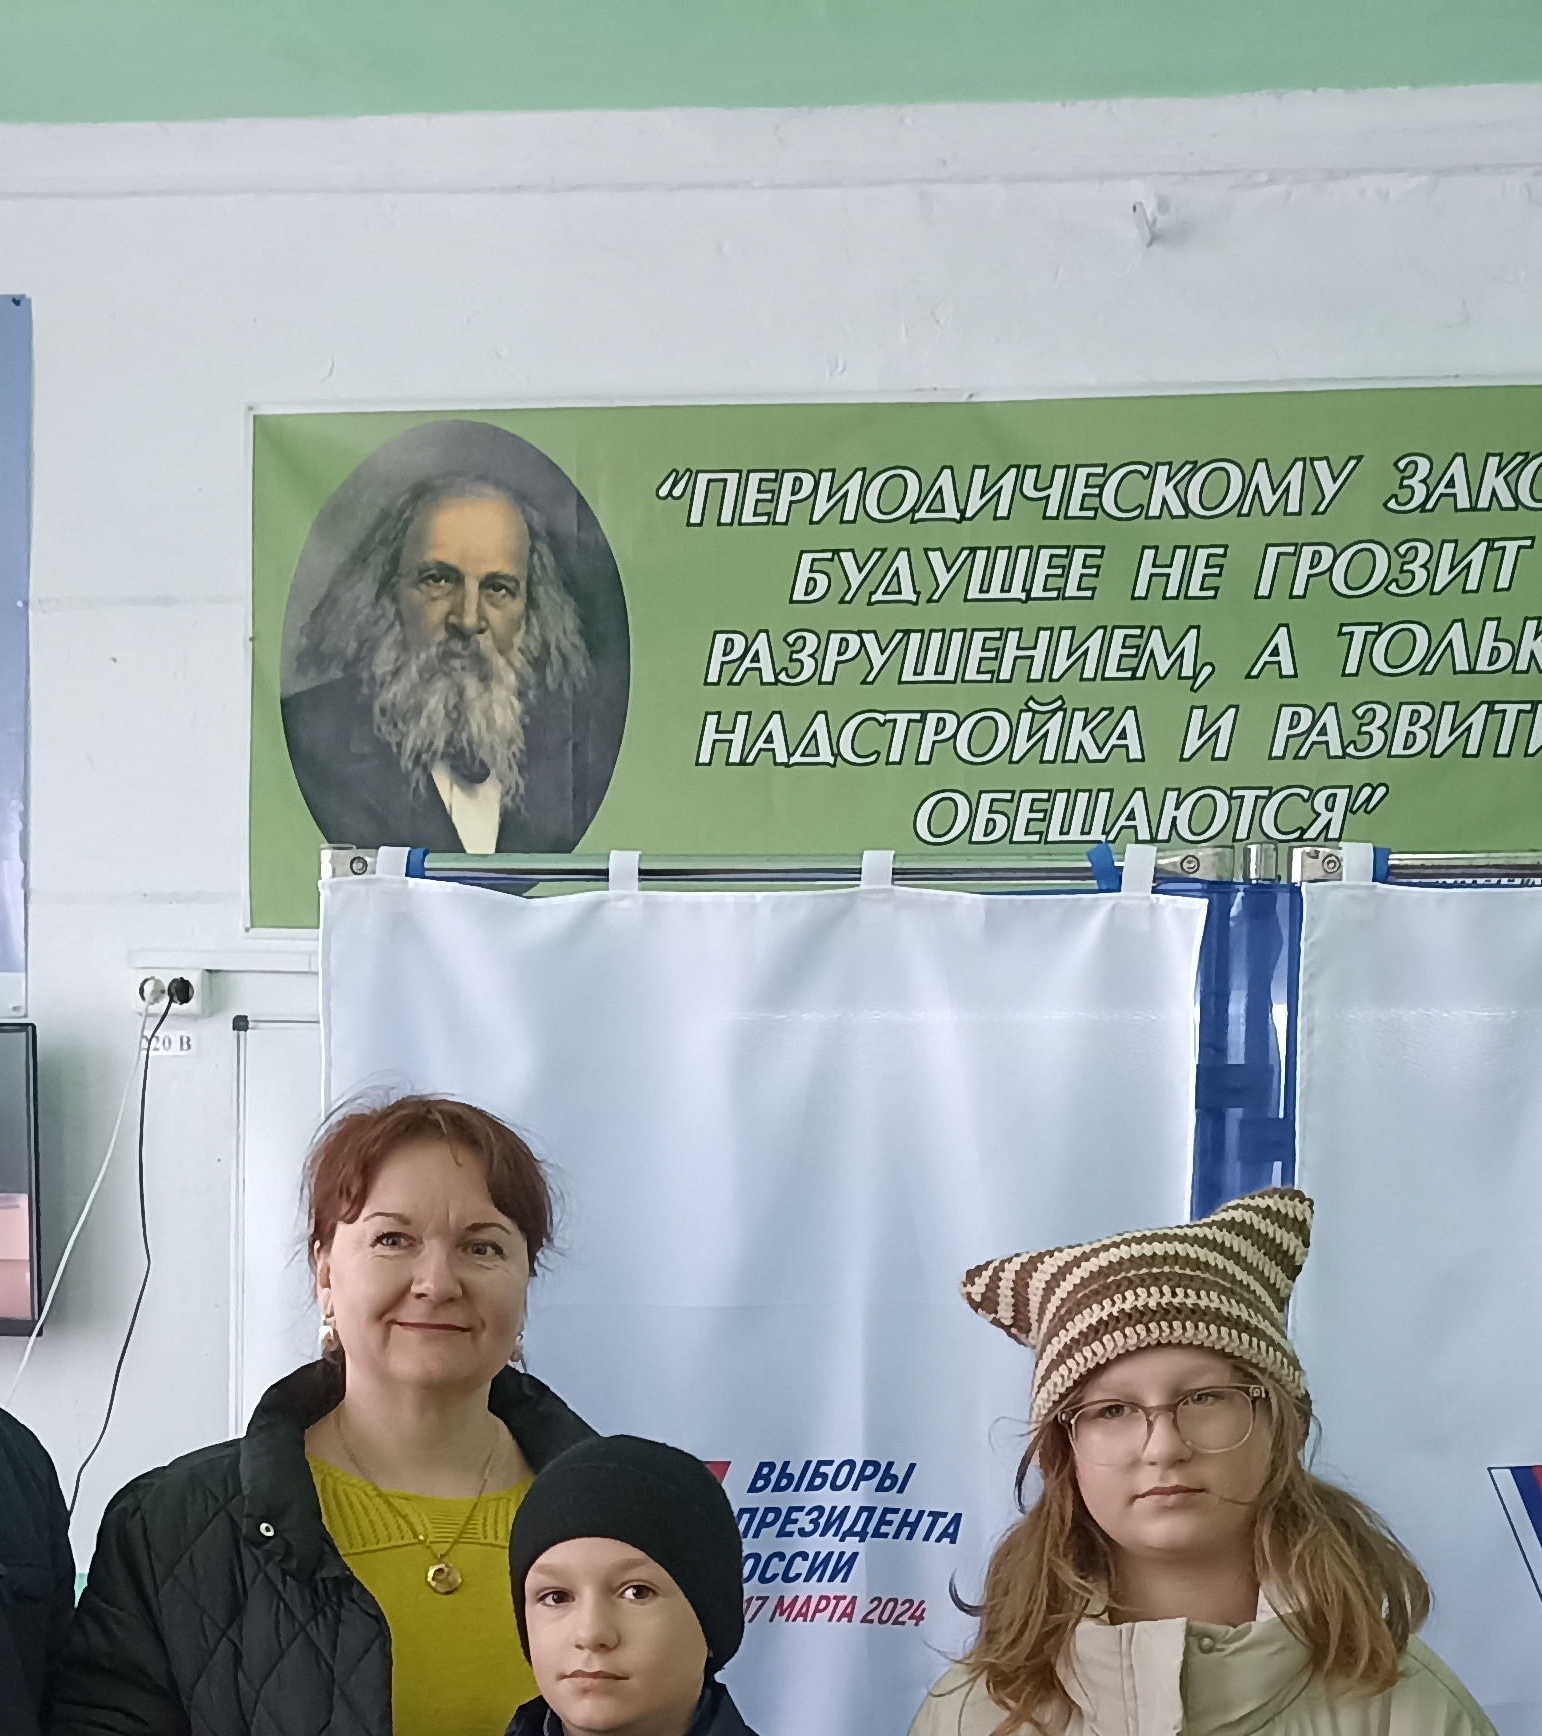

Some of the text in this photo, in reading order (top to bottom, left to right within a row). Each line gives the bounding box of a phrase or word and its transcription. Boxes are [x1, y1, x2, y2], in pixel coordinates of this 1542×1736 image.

[789, 536, 1535, 605] БУДУЩЕЕ НЕ ГРОЗИТ
[703, 625, 1214, 691] РАЗРУШЕНИЕМ,
[1245, 623, 1297, 679] А
[696, 696, 1144, 766] НАДСТРОЙКА
[1180, 705, 1239, 761] И
[747, 1459, 917, 1494] ВЫБОРЫ
[736, 1505, 963, 1544] ПРЕЗИДЕНТА
[742, 1551, 859, 1584] ОССИИ
[769, 1595, 856, 1623] МАРТА
[860, 1597, 926, 1626] 2024
